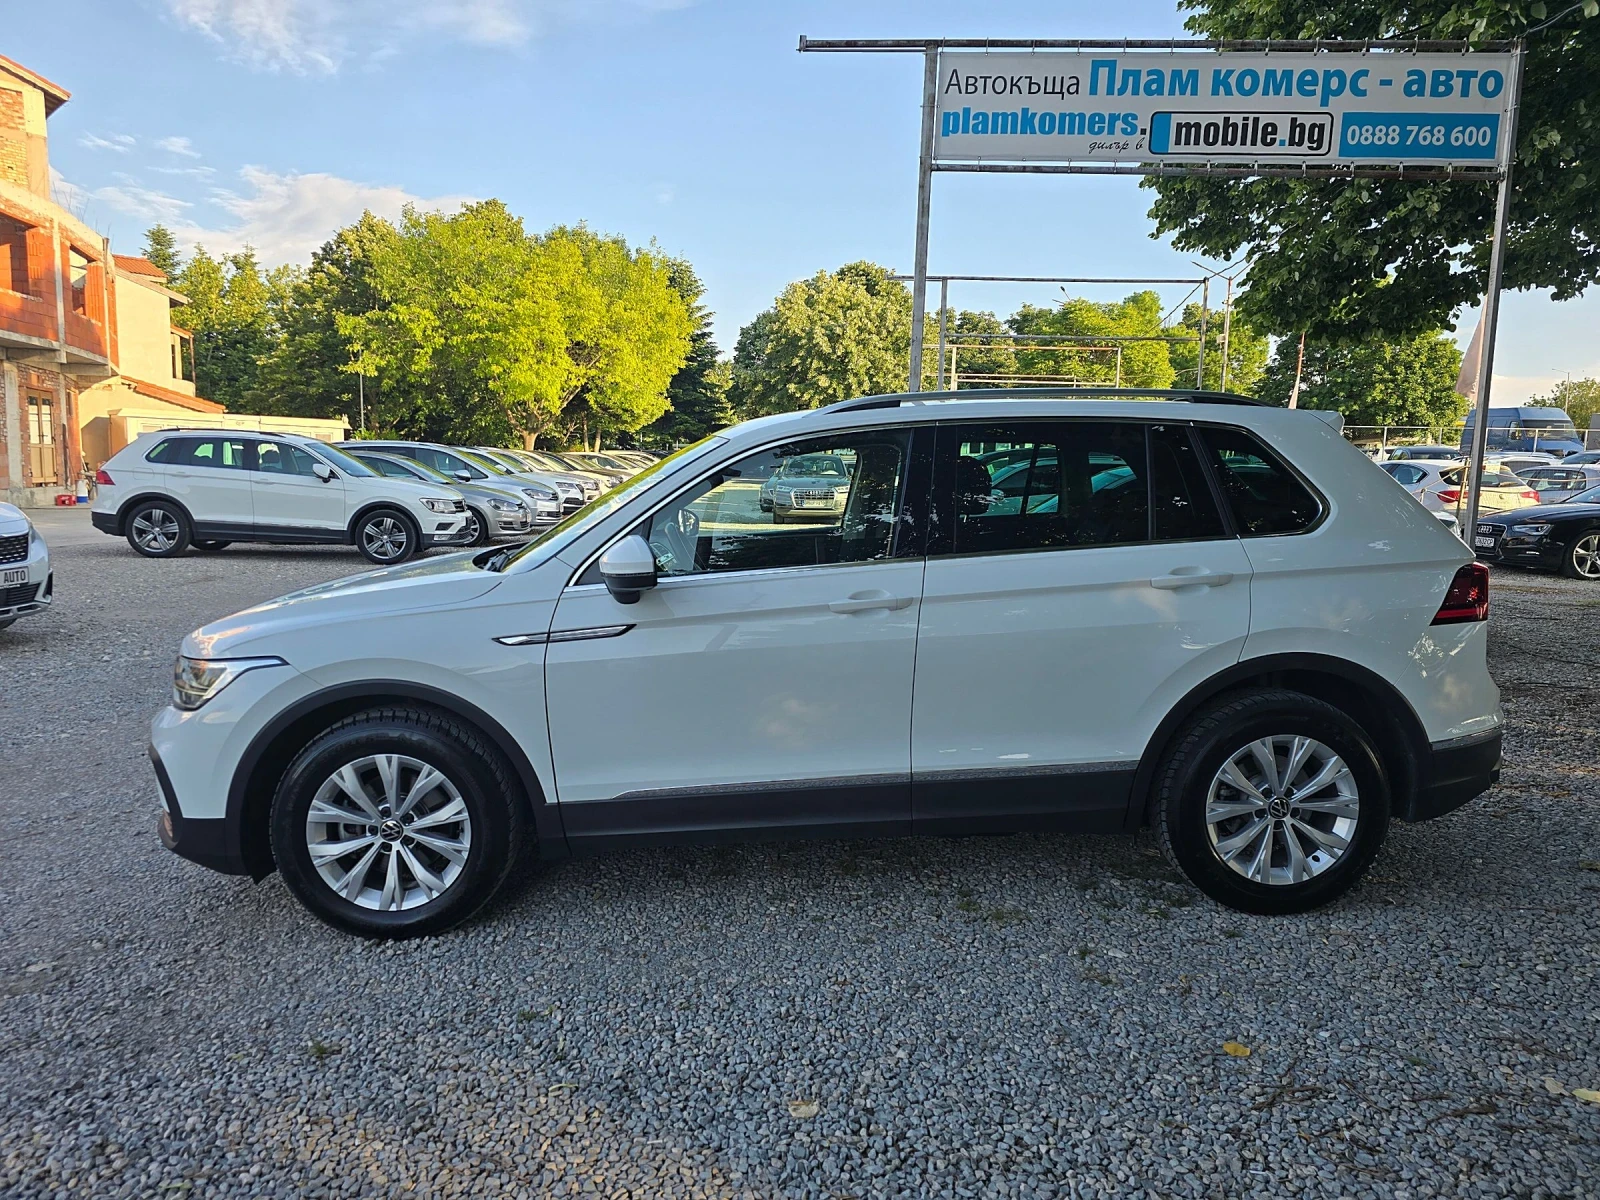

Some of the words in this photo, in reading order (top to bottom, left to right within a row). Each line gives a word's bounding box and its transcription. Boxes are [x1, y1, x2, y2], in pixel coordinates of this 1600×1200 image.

[944, 68, 1080, 100] Автокъща
[1089, 59, 1199, 97] Плам
[1211, 68, 1370, 107] комерс
[1379, 78, 1393, 86] -
[1403, 68, 1504, 98] авто
[942, 107, 1146, 137] plamkomers.
[1174, 116, 1326, 151] mobile.bg
[1346, 125, 1400, 146] 0888
[1405, 125, 1446, 146] 768
[1450, 126, 1491, 147] 600
[1088, 139, 1130, 154] дилър
[4, 570, 26, 584] AUTO
